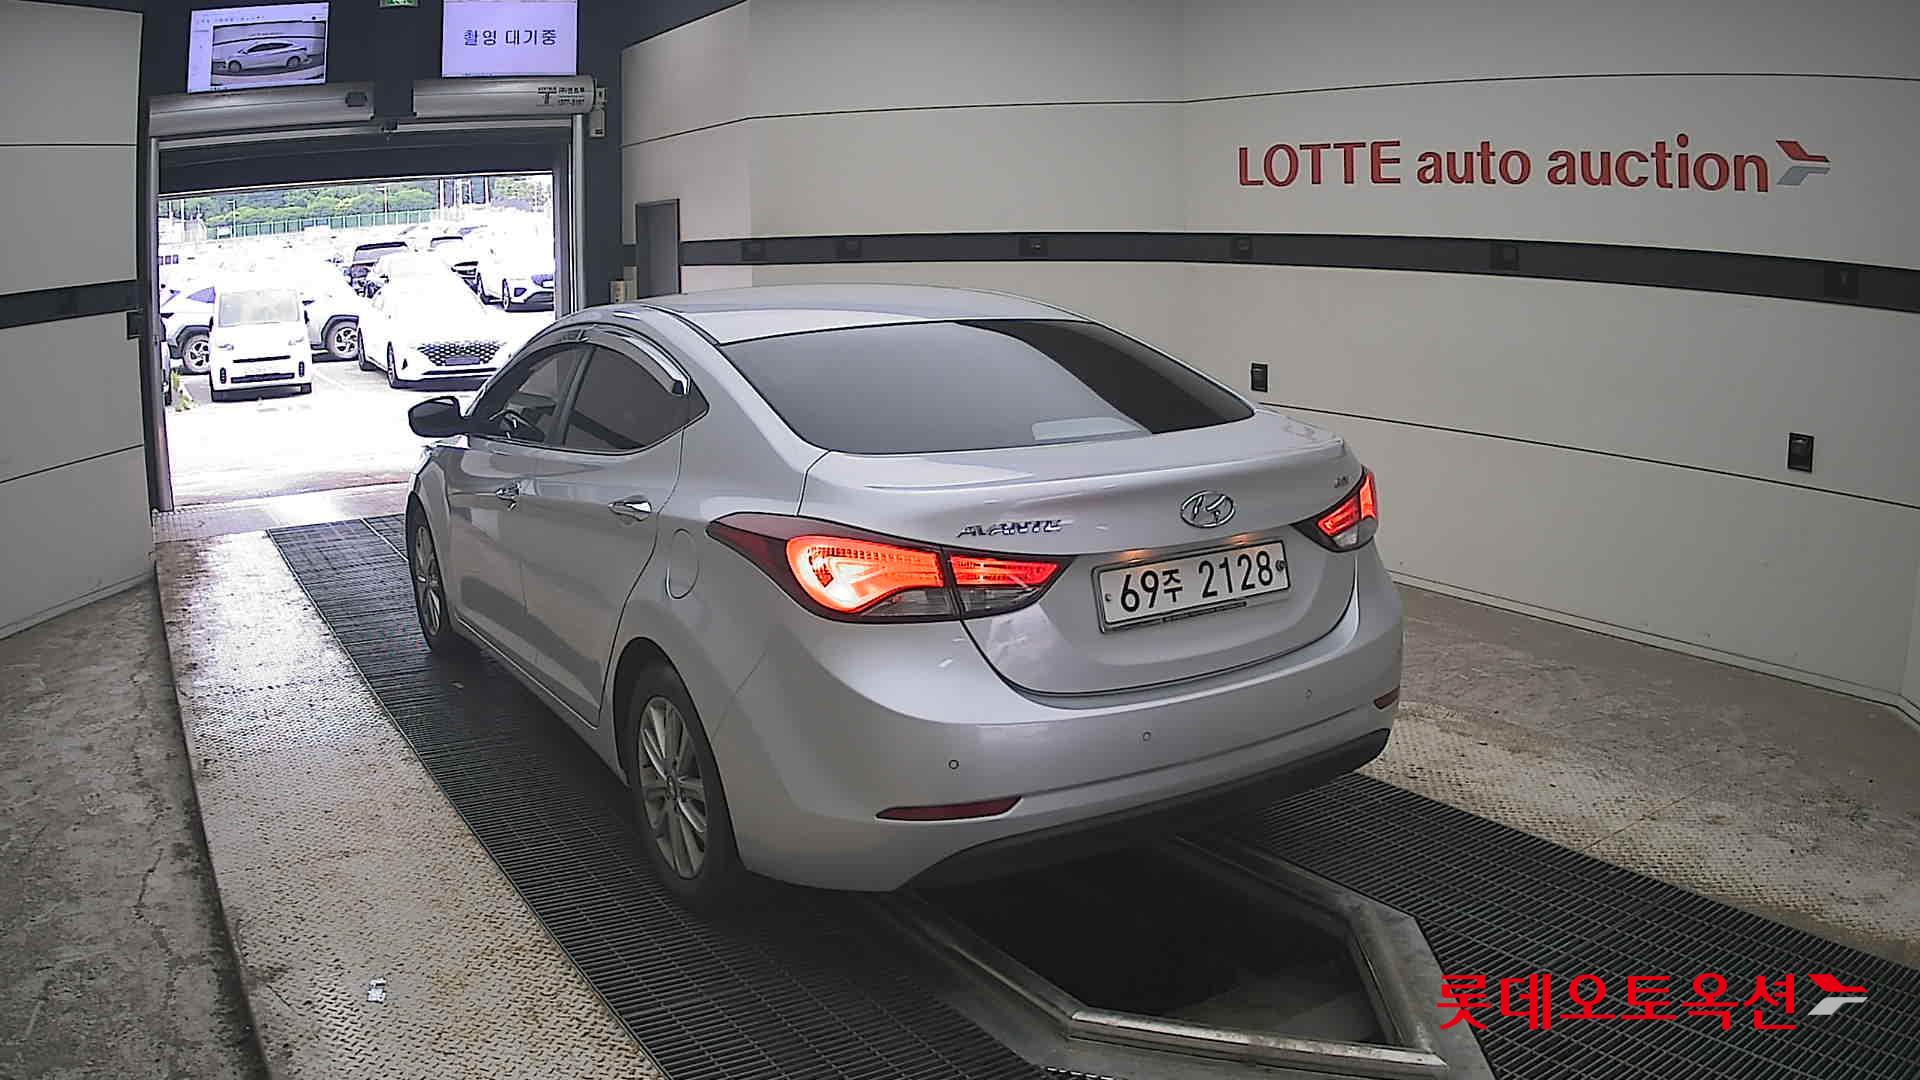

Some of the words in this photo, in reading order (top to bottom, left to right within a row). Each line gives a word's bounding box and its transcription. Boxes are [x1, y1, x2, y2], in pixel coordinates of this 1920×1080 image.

[505, 29, 557, 46] 대기중
[1239, 140, 1401, 187] LOTTE
[1416, 140, 1532, 185] auto
[1547, 133, 1769, 192] auction
[1120, 568, 1183, 613] 69주
[1198, 550, 1274, 599] 2128
